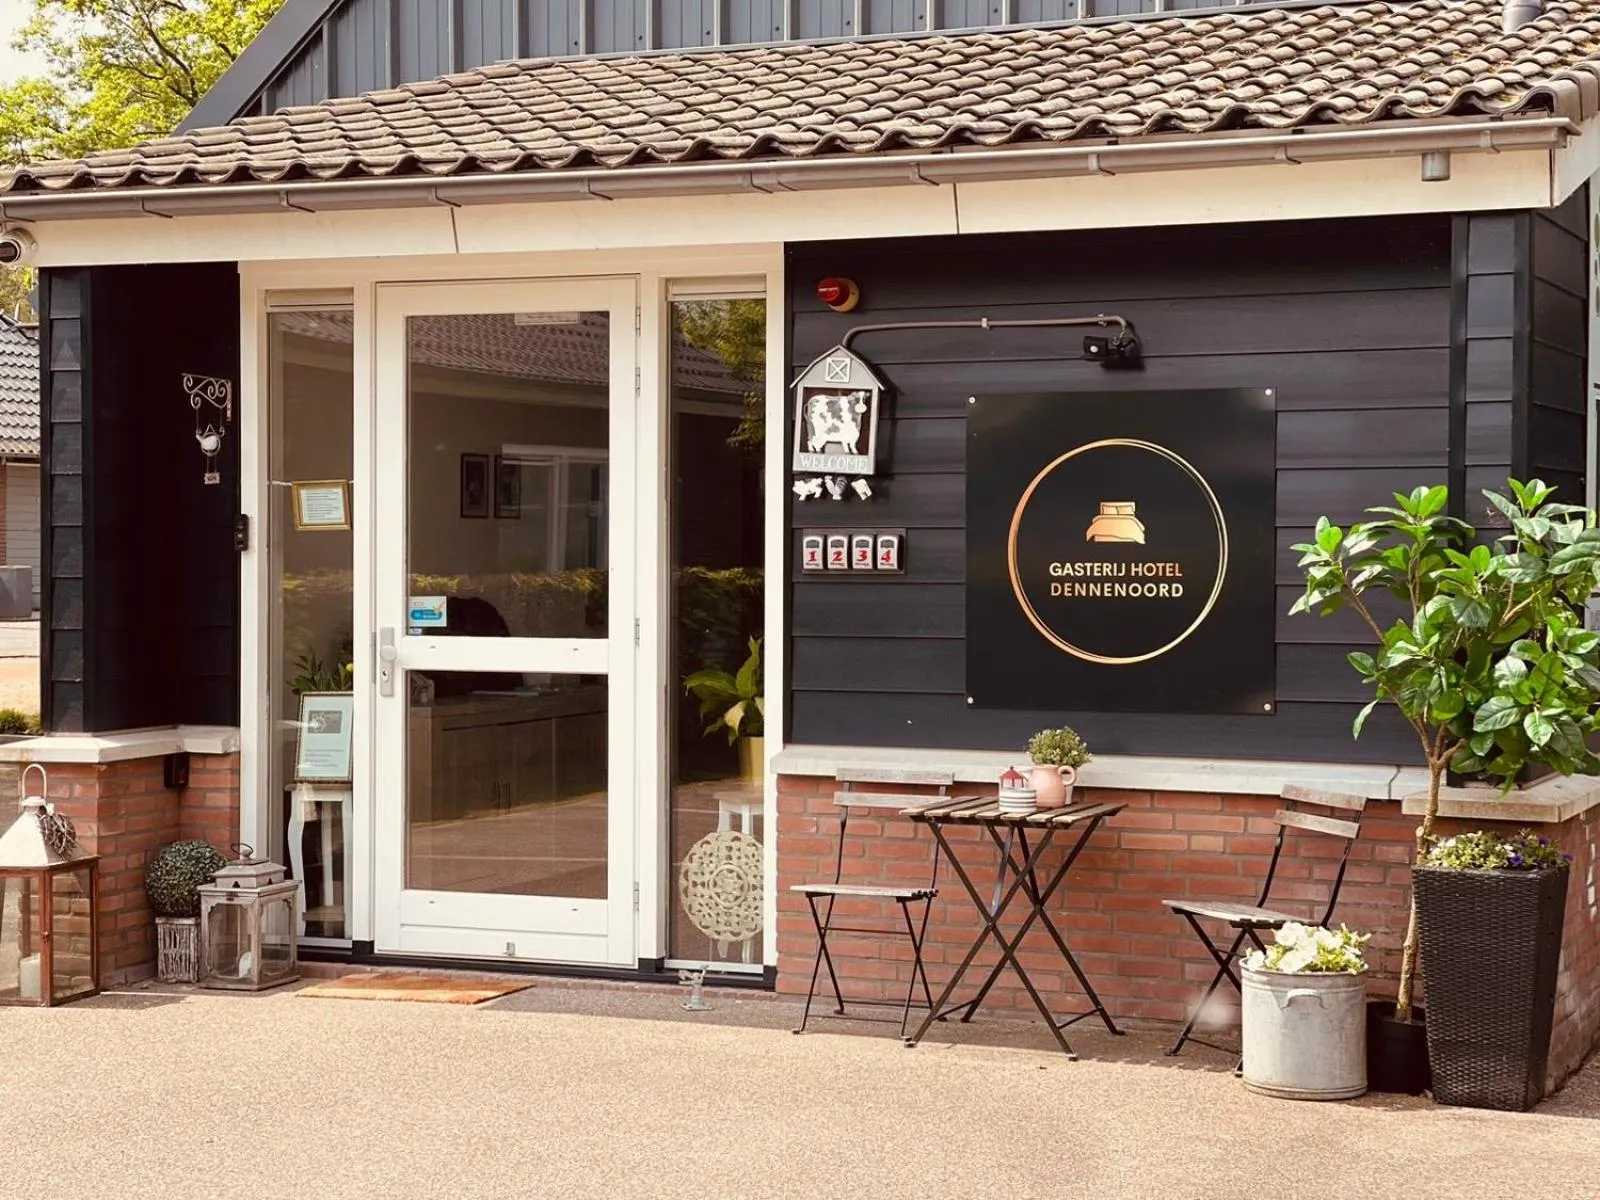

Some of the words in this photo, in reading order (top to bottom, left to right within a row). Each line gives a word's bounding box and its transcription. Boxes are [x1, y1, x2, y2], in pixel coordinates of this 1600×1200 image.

[799, 454, 869, 471] WELCOME
[807, 550, 817, 562] 1
[831, 550, 843, 562] 2
[856, 550, 868, 562] 3
[880, 550, 891, 562] 4
[1049, 562, 1126, 577] GASTERIJ
[1131, 562, 1183, 577] HOTEL
[1050, 583, 1184, 597] DENNENOORD
